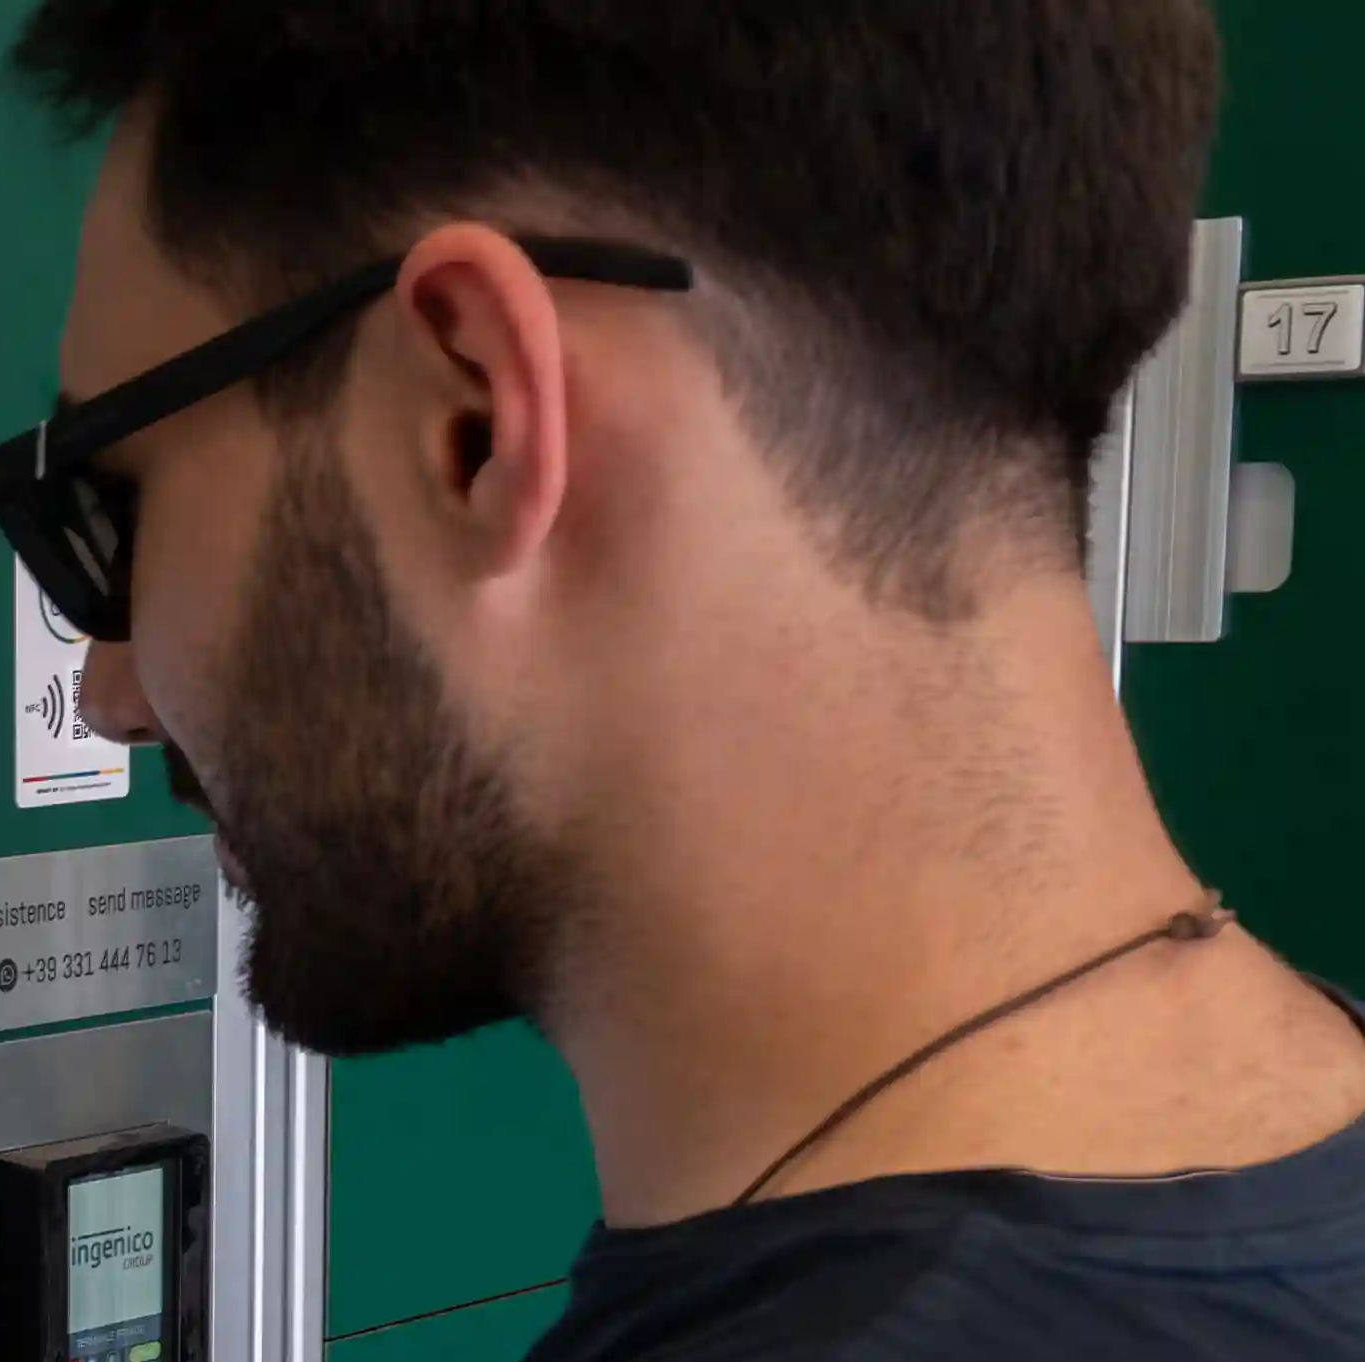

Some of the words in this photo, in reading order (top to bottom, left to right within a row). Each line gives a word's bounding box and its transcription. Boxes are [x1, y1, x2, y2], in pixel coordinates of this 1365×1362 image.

[1268, 302, 1338, 356] 17
[25, 703, 41, 714] NFC
[88, 888, 126, 916] send
[130, 883, 201, 909] message
[22, 957, 57, 983] +39
[63, 952, 94, 979] 331
[100, 946, 130, 973] 444
[136, 942, 157, 968] 76
[162, 938, 182, 965] 13
[71, 1225, 154, 1269] ingenico
